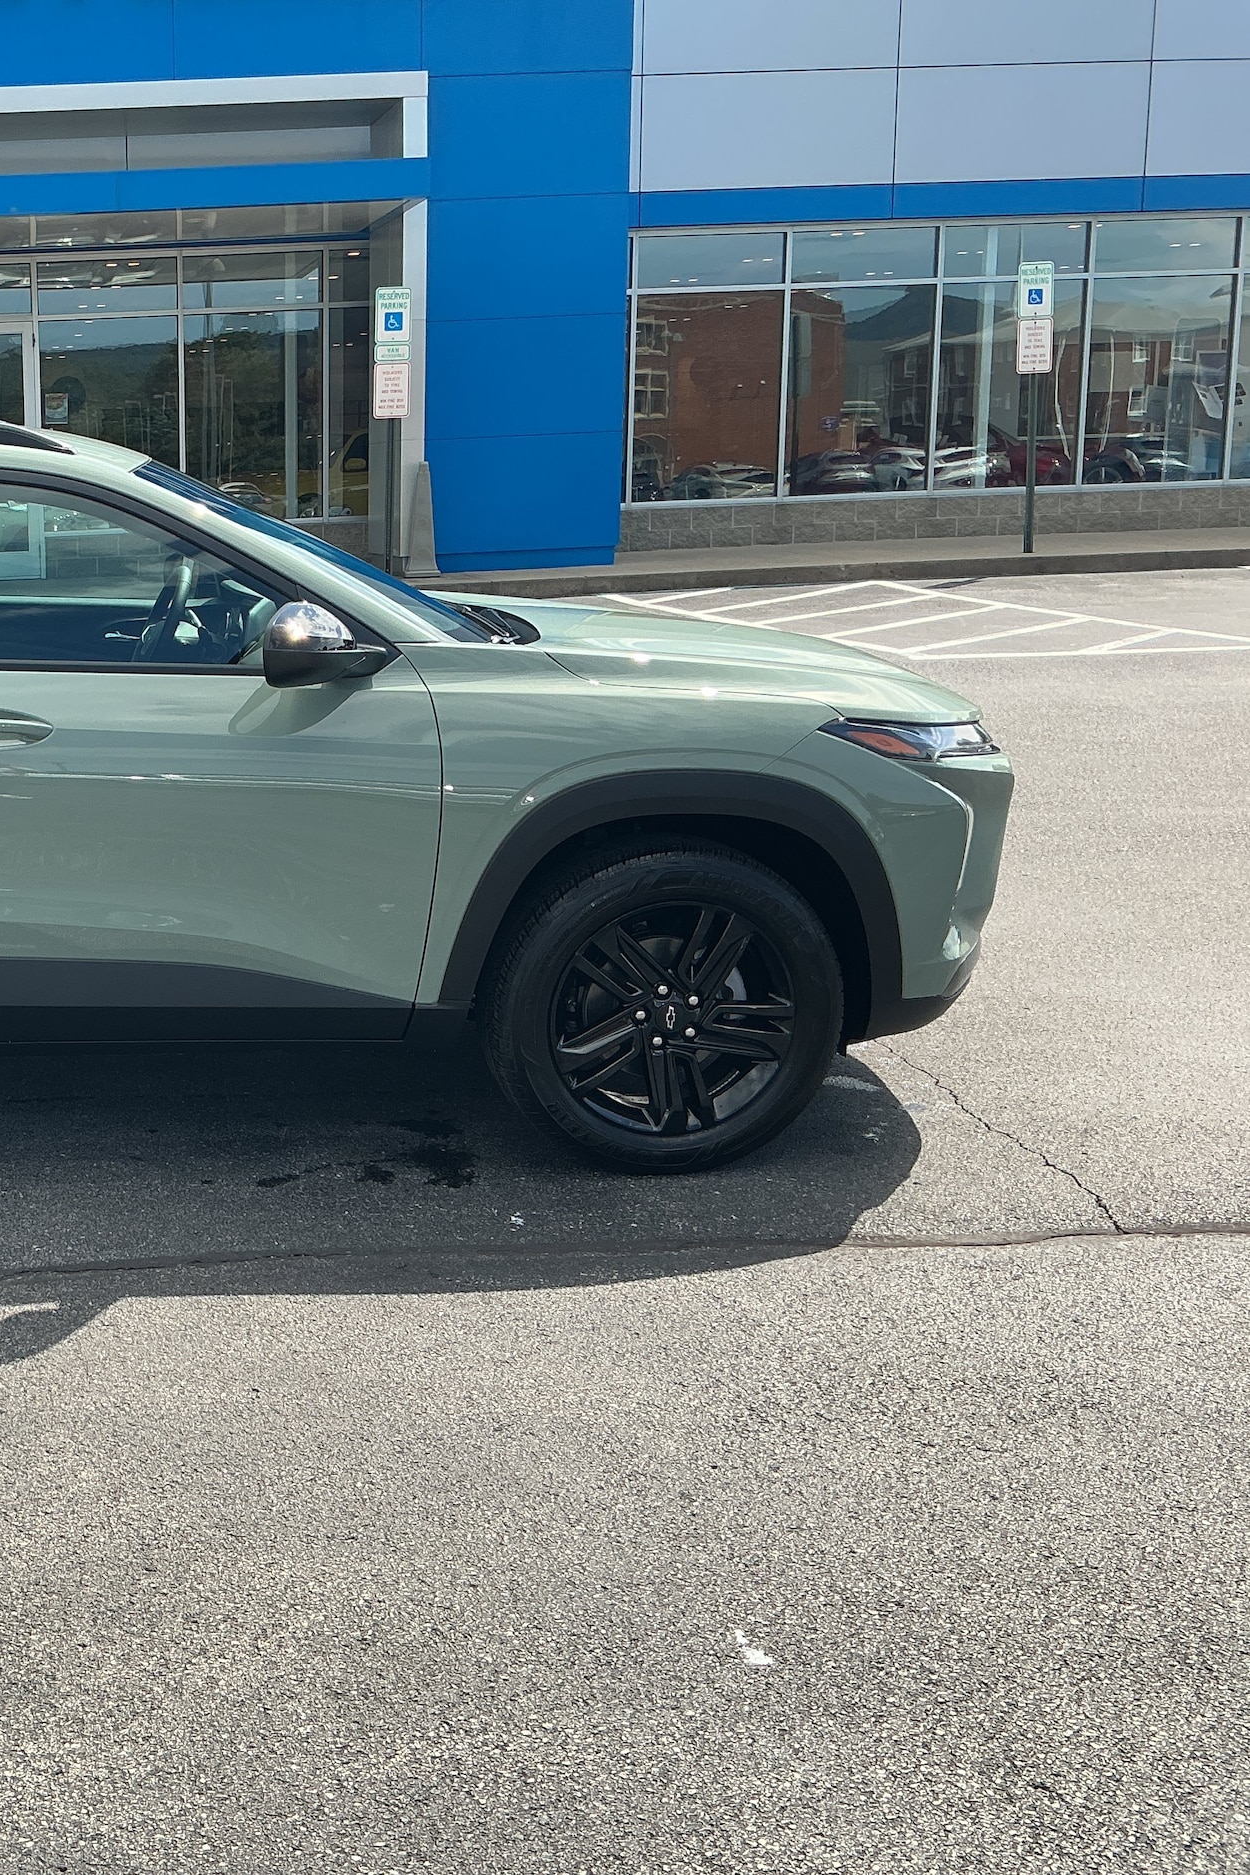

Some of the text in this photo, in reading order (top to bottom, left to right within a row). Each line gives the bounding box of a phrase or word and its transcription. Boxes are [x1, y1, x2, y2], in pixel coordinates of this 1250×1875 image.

[1023, 277, 1050, 285] PARKING
[378, 292, 410, 301] RESERVED
[380, 302, 408, 310] PARKING
